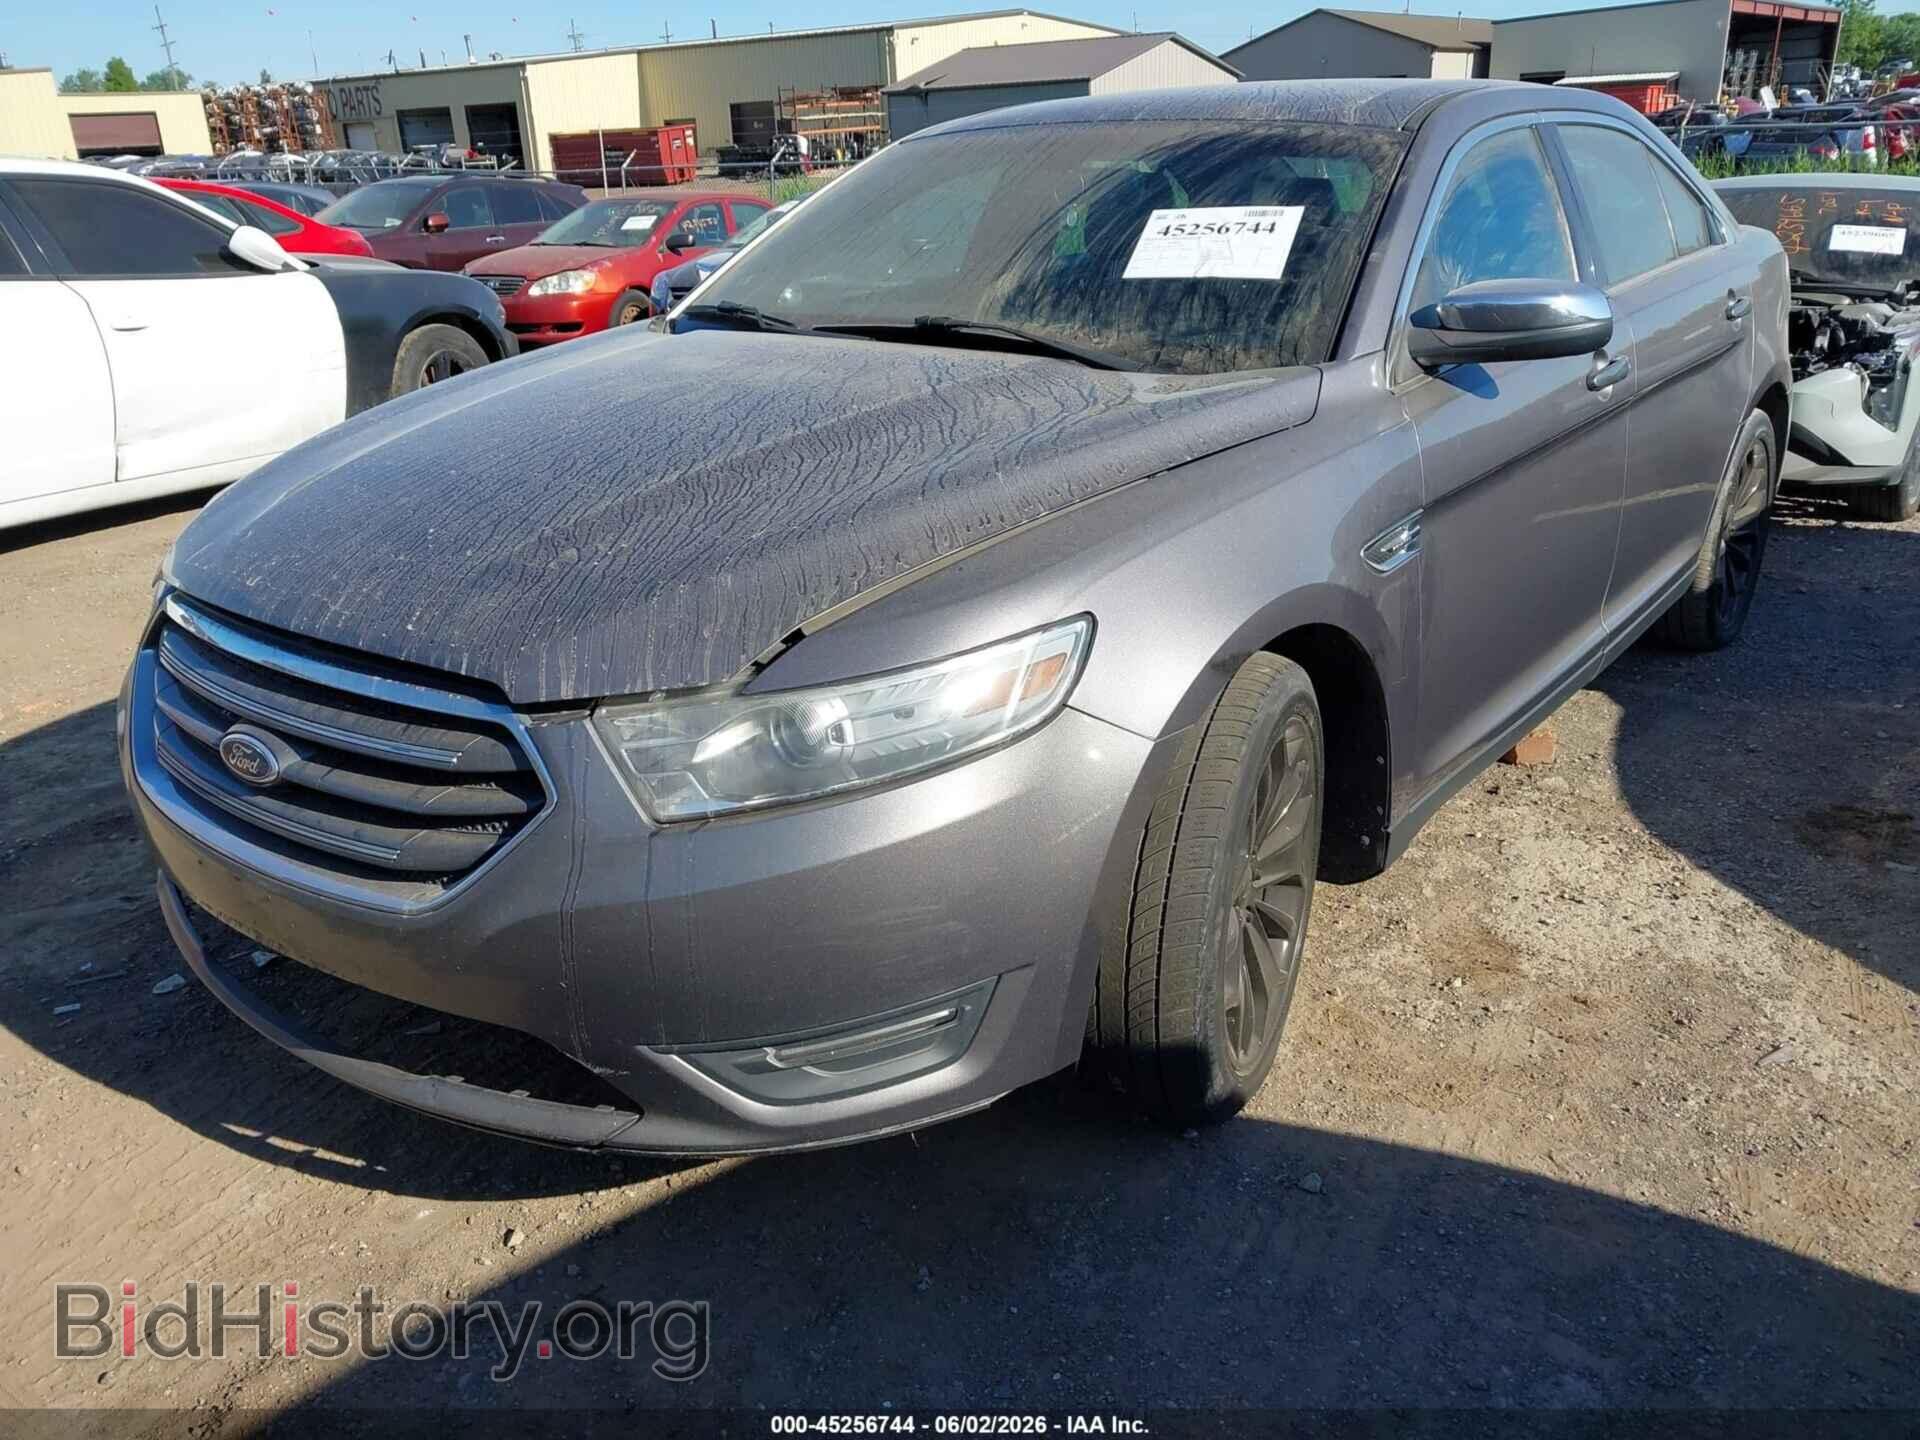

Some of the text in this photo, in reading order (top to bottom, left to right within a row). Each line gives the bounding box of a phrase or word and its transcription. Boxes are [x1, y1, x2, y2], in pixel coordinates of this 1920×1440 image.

[339, 84, 382, 117] PARTS
[1156, 221, 1277, 237] 45256744
[229, 743, 260, 774] Ford
